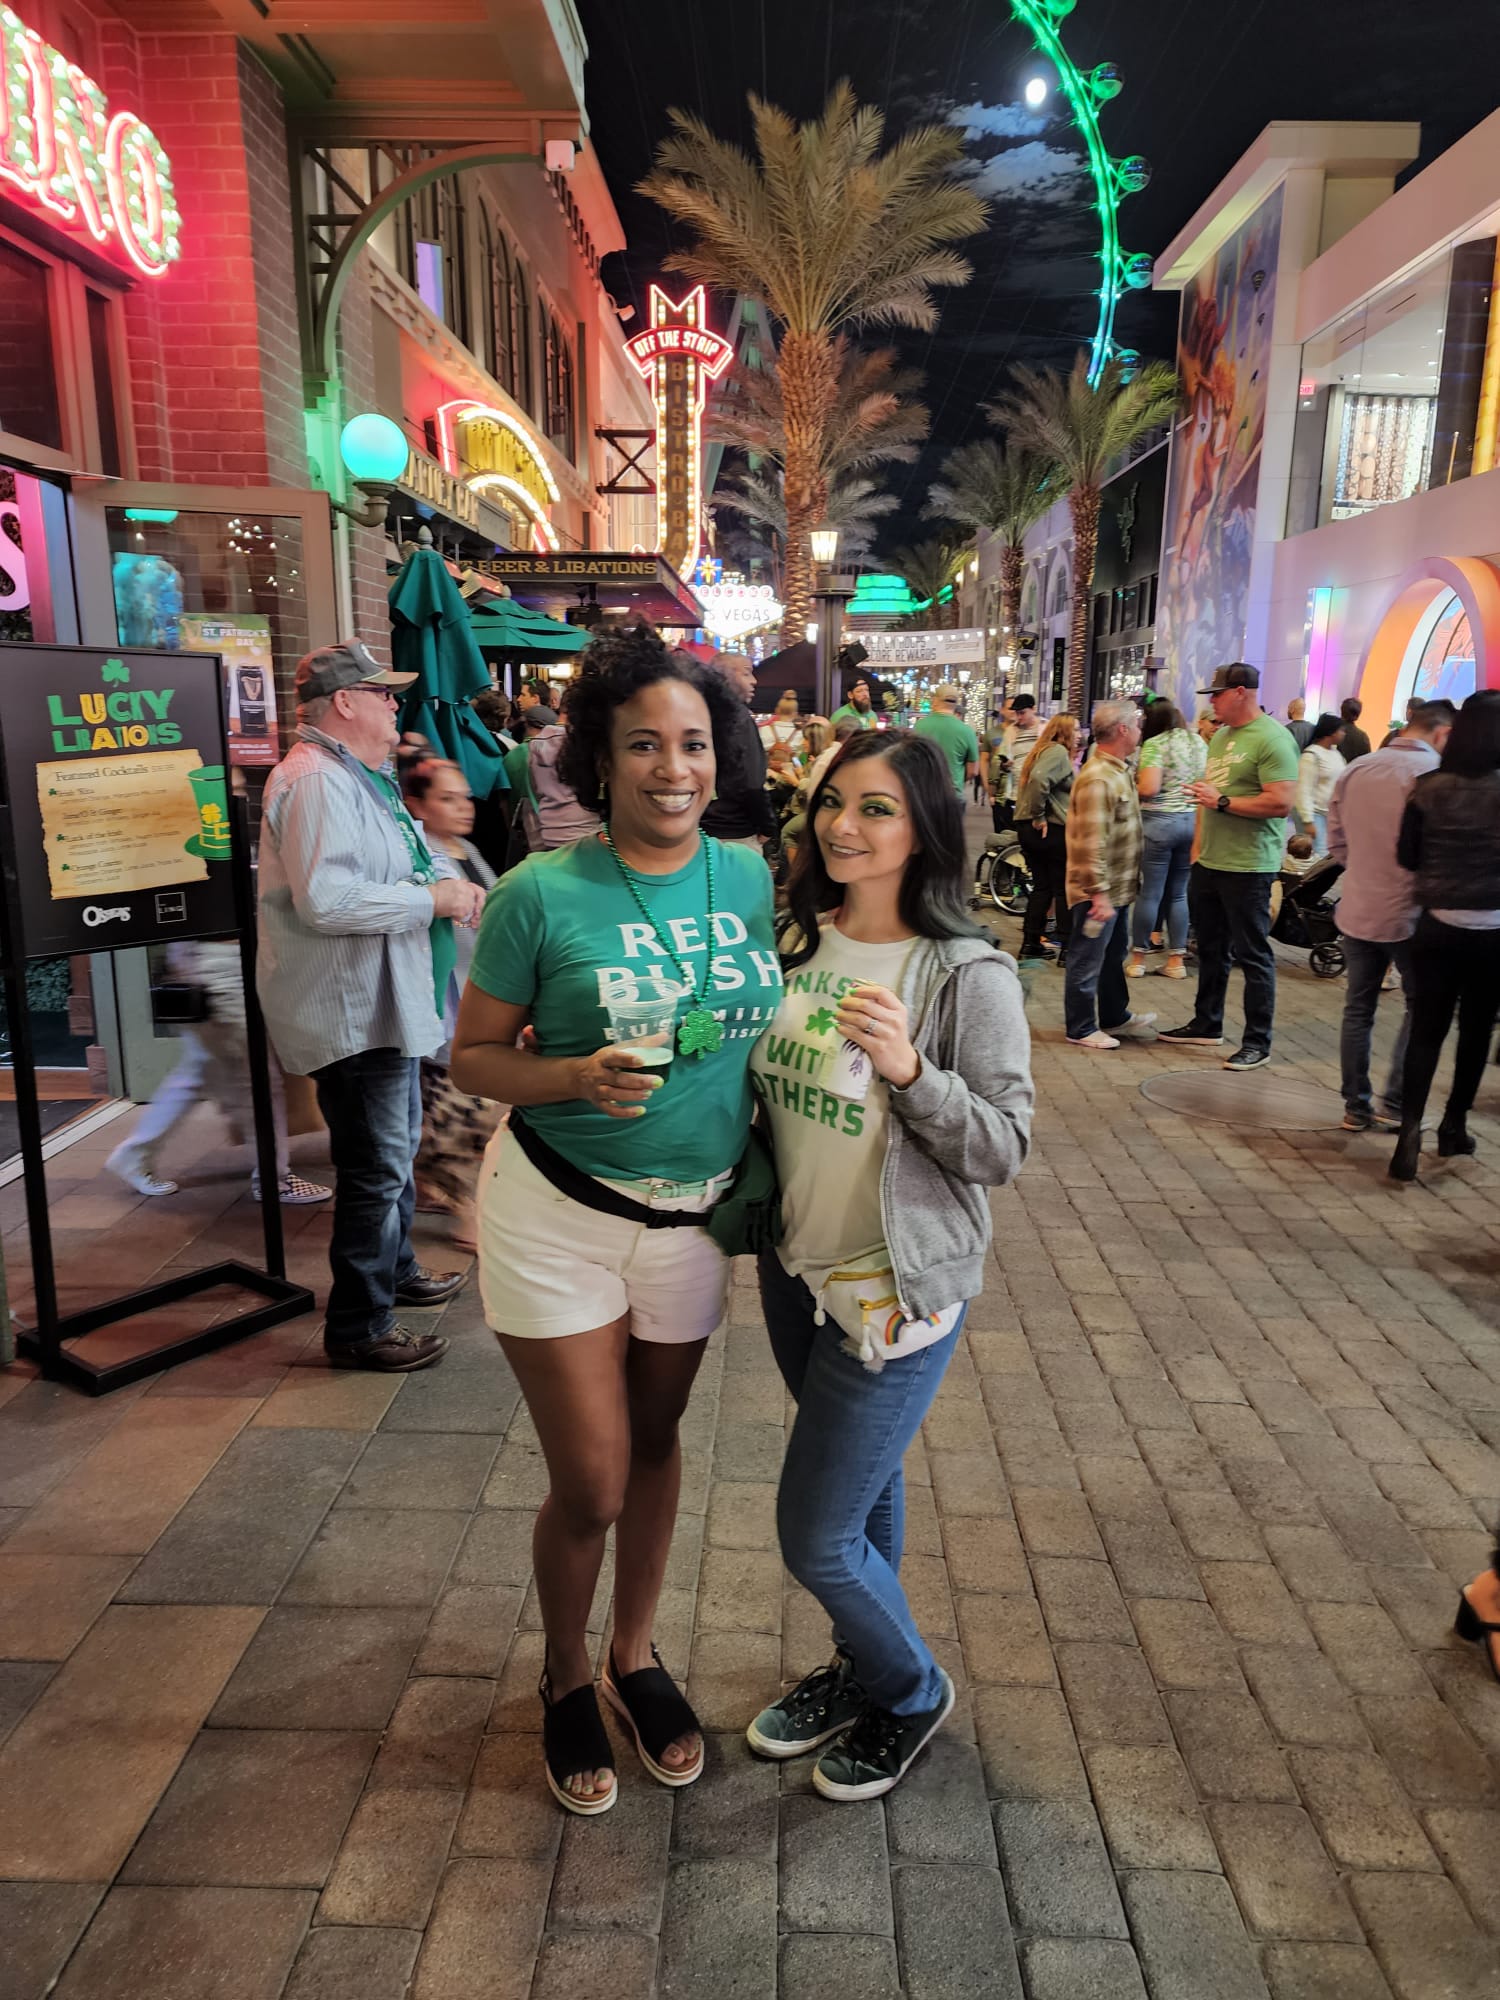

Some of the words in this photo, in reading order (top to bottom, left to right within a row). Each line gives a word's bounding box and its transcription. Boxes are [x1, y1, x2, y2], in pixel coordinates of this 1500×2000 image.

[633, 335, 656, 357] OFF
[657, 330, 680, 348] THE
[682, 331, 720, 357] STRIP
[671, 361, 684, 494] BISTRO
[534, 560, 550, 574] &
[553, 560, 658, 575] LIBATIONS
[723, 608, 770, 622] VEGAS
[616, 911, 749, 958] RED
[593, 950, 785, 1008] BUSH
[750, 1068, 866, 1138] OTHERS
